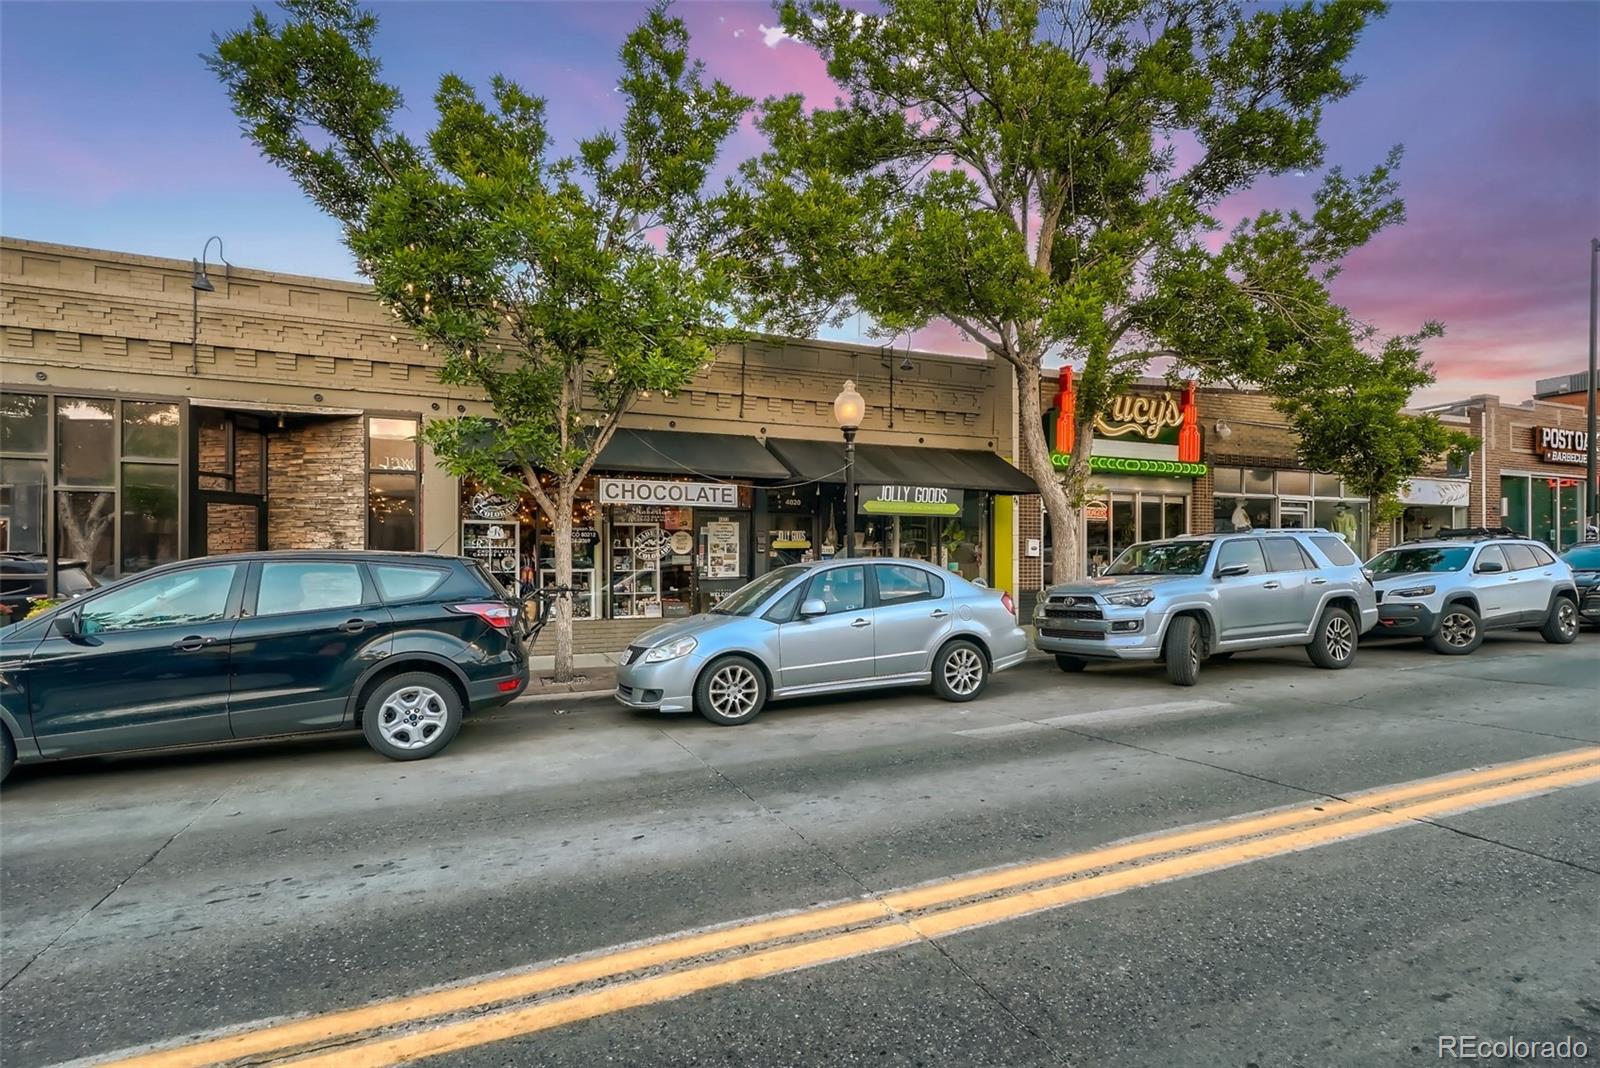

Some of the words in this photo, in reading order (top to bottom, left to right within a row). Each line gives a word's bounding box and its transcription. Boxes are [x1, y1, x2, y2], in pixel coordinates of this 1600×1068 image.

[1542, 427, 1574, 449] POST
[605, 482, 733, 503] CHOCOLATE
[877, 485, 910, 502] JOLLY
[915, 487, 948, 504] GOODS
